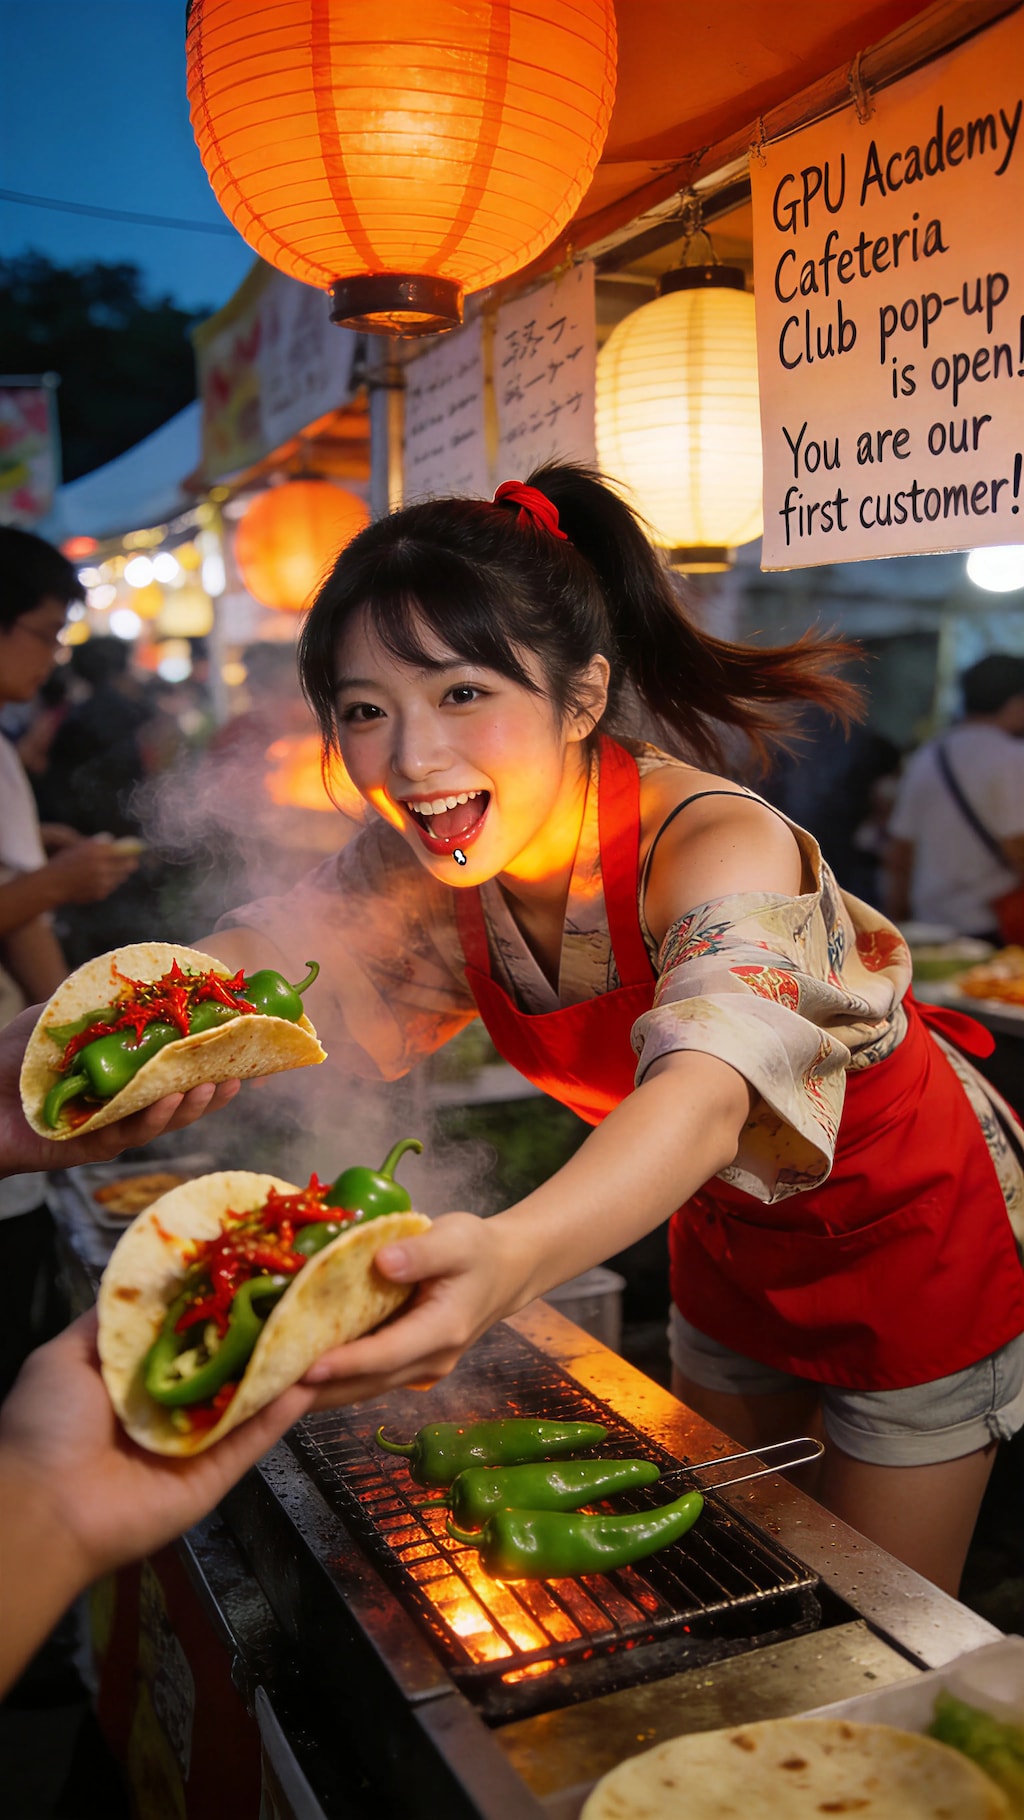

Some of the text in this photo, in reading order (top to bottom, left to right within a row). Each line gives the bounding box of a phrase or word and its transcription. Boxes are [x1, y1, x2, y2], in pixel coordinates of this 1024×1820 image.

[773, 99, 1023, 235] GPU Academy
[775, 212, 950, 304] Cafeteria
[779, 272, 1010, 370] Club pop-up
[892, 314, 1024, 408] is open!
[782, 414, 992, 479] You are our
[778, 452, 1023, 546] first customer!
